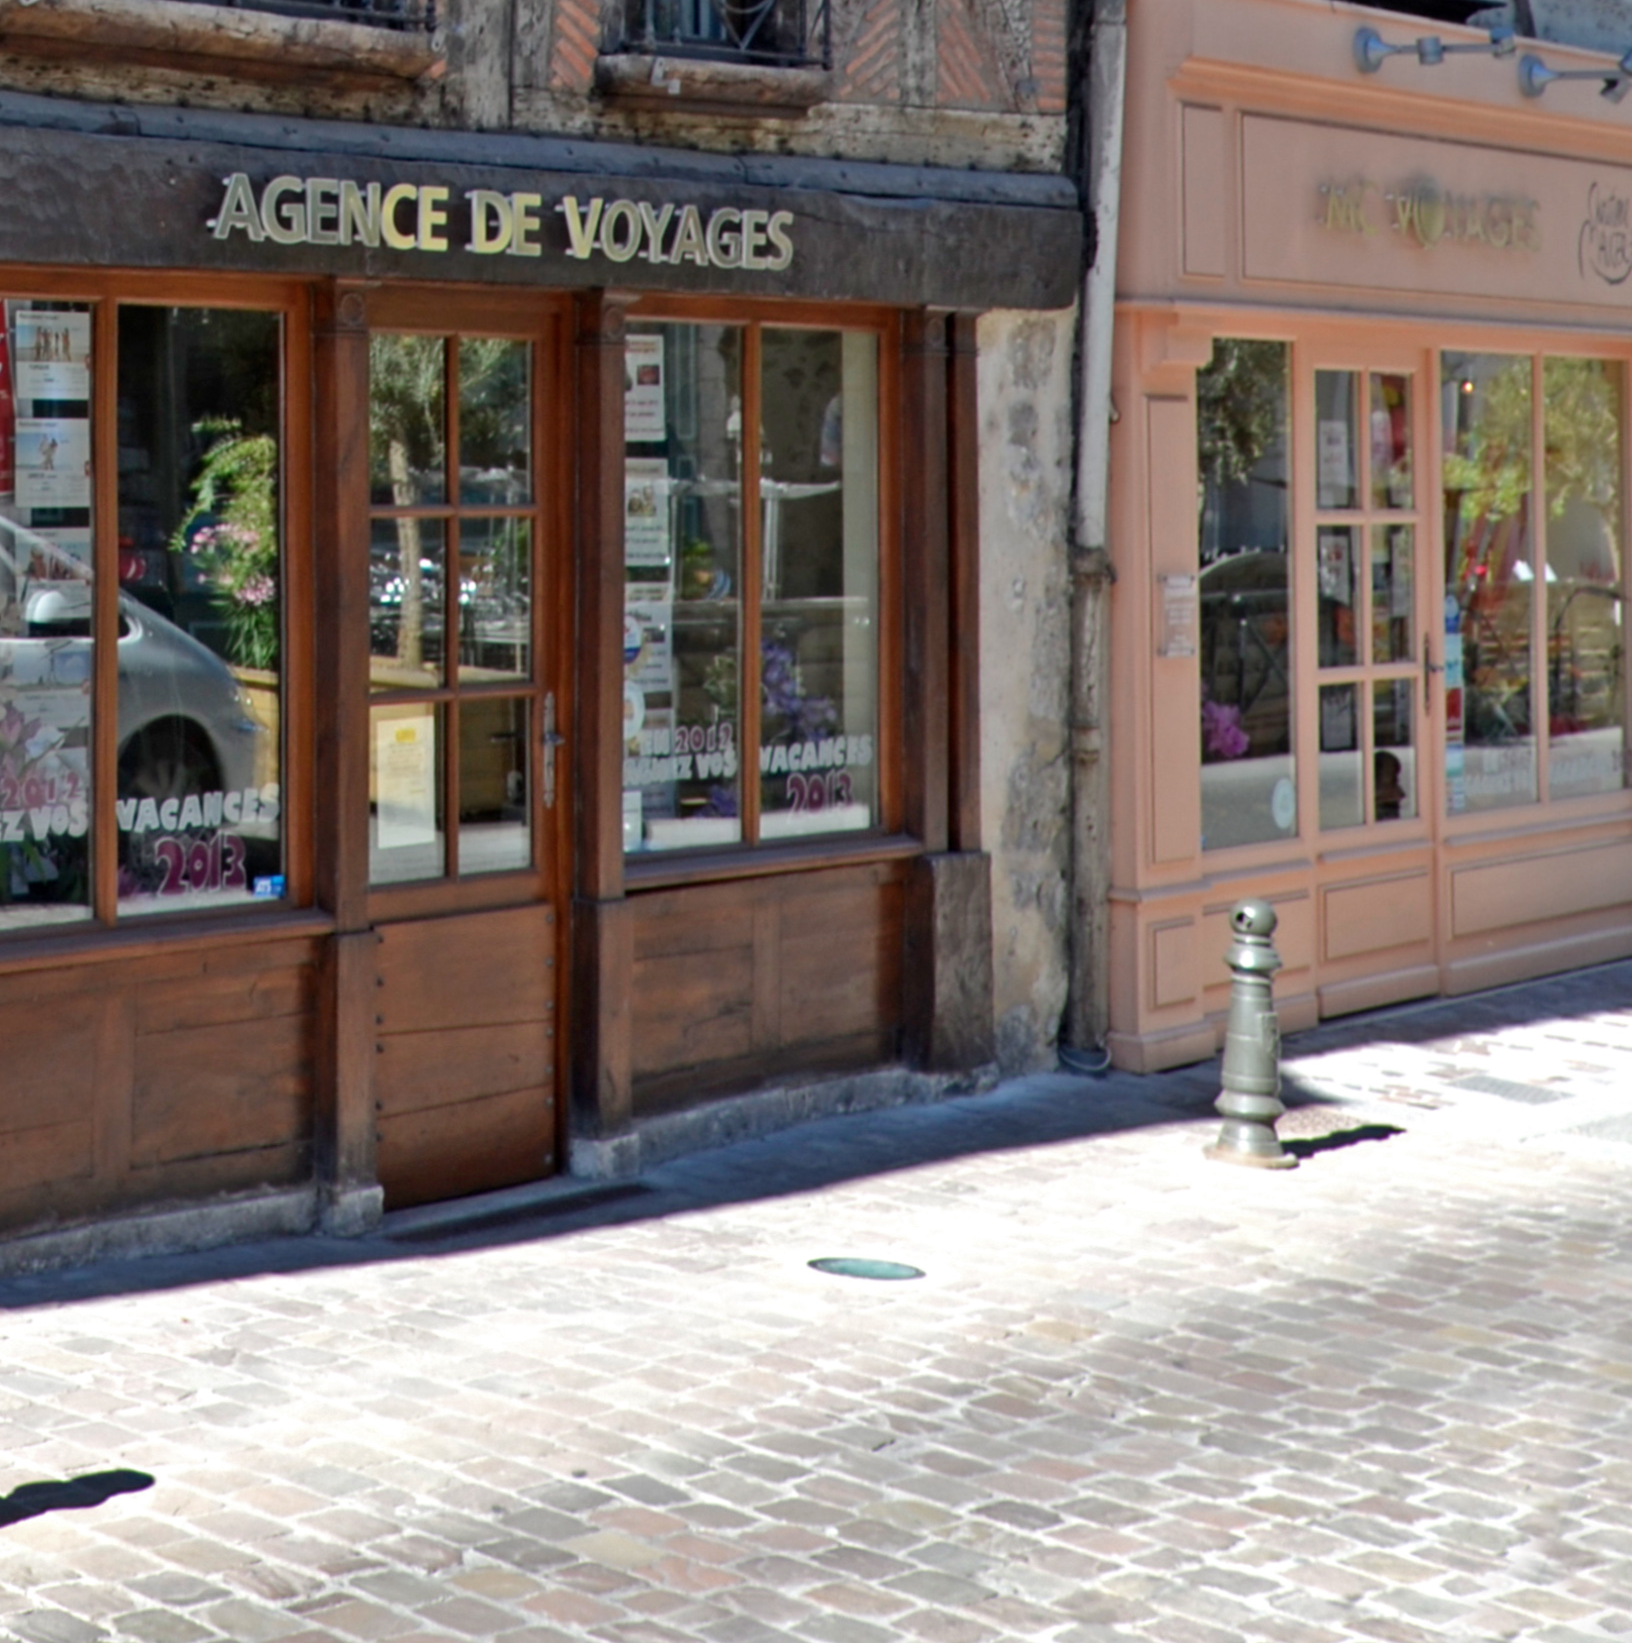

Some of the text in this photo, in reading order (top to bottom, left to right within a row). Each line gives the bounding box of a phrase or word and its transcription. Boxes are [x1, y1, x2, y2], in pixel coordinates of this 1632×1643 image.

[211, 172, 794, 272] AGENCE DE VOYAGES
[674, 721, 734, 755] 2012
[759, 734, 874, 774] VACANCES
[3, 771, 81, 809] 2012
[30, 800, 89, 842] VOS
[116, 783, 280, 833] VACANCES
[786, 768, 854, 822] 2013
[154, 827, 248, 898] 2013
